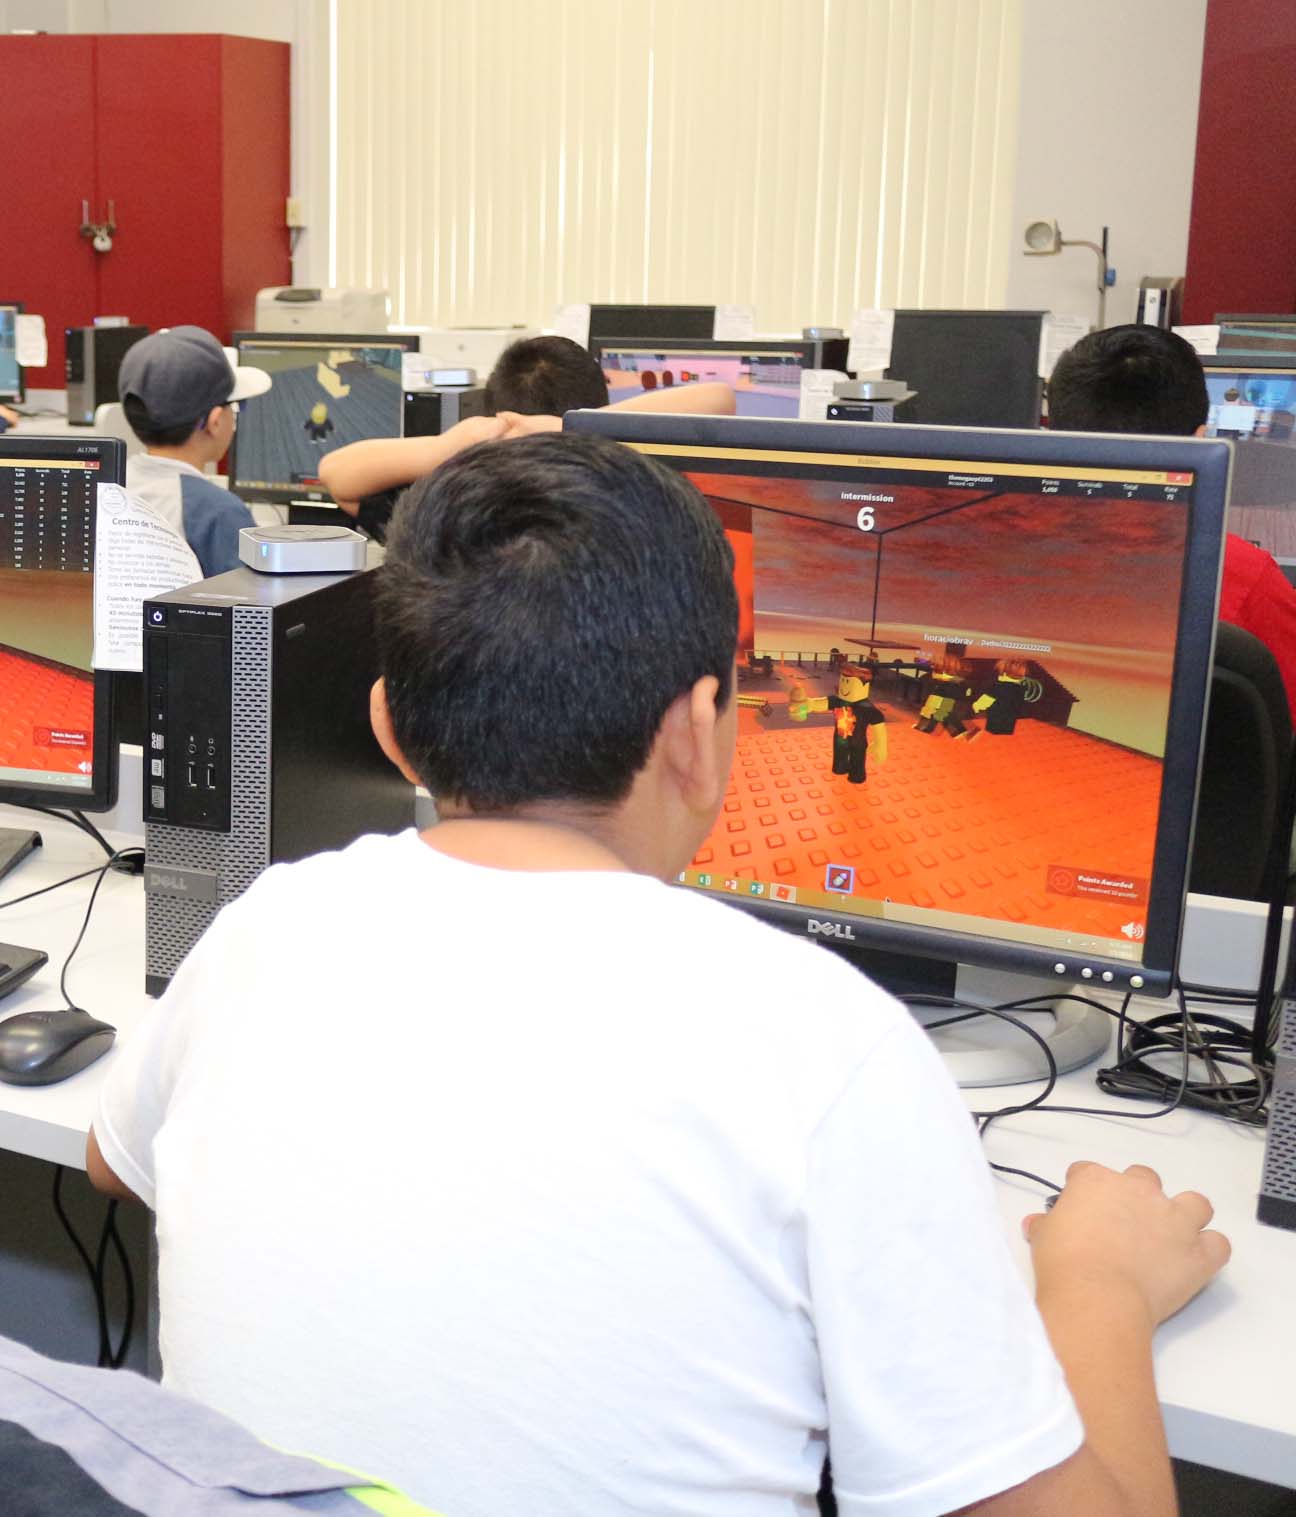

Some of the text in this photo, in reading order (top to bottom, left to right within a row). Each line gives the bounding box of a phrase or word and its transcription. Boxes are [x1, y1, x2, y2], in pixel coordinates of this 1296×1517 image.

[111, 517, 140, 527] Centro
[856, 506, 875, 532] 6
[150, 872, 188, 891] DELL
[807, 918, 856, 941] DELL
